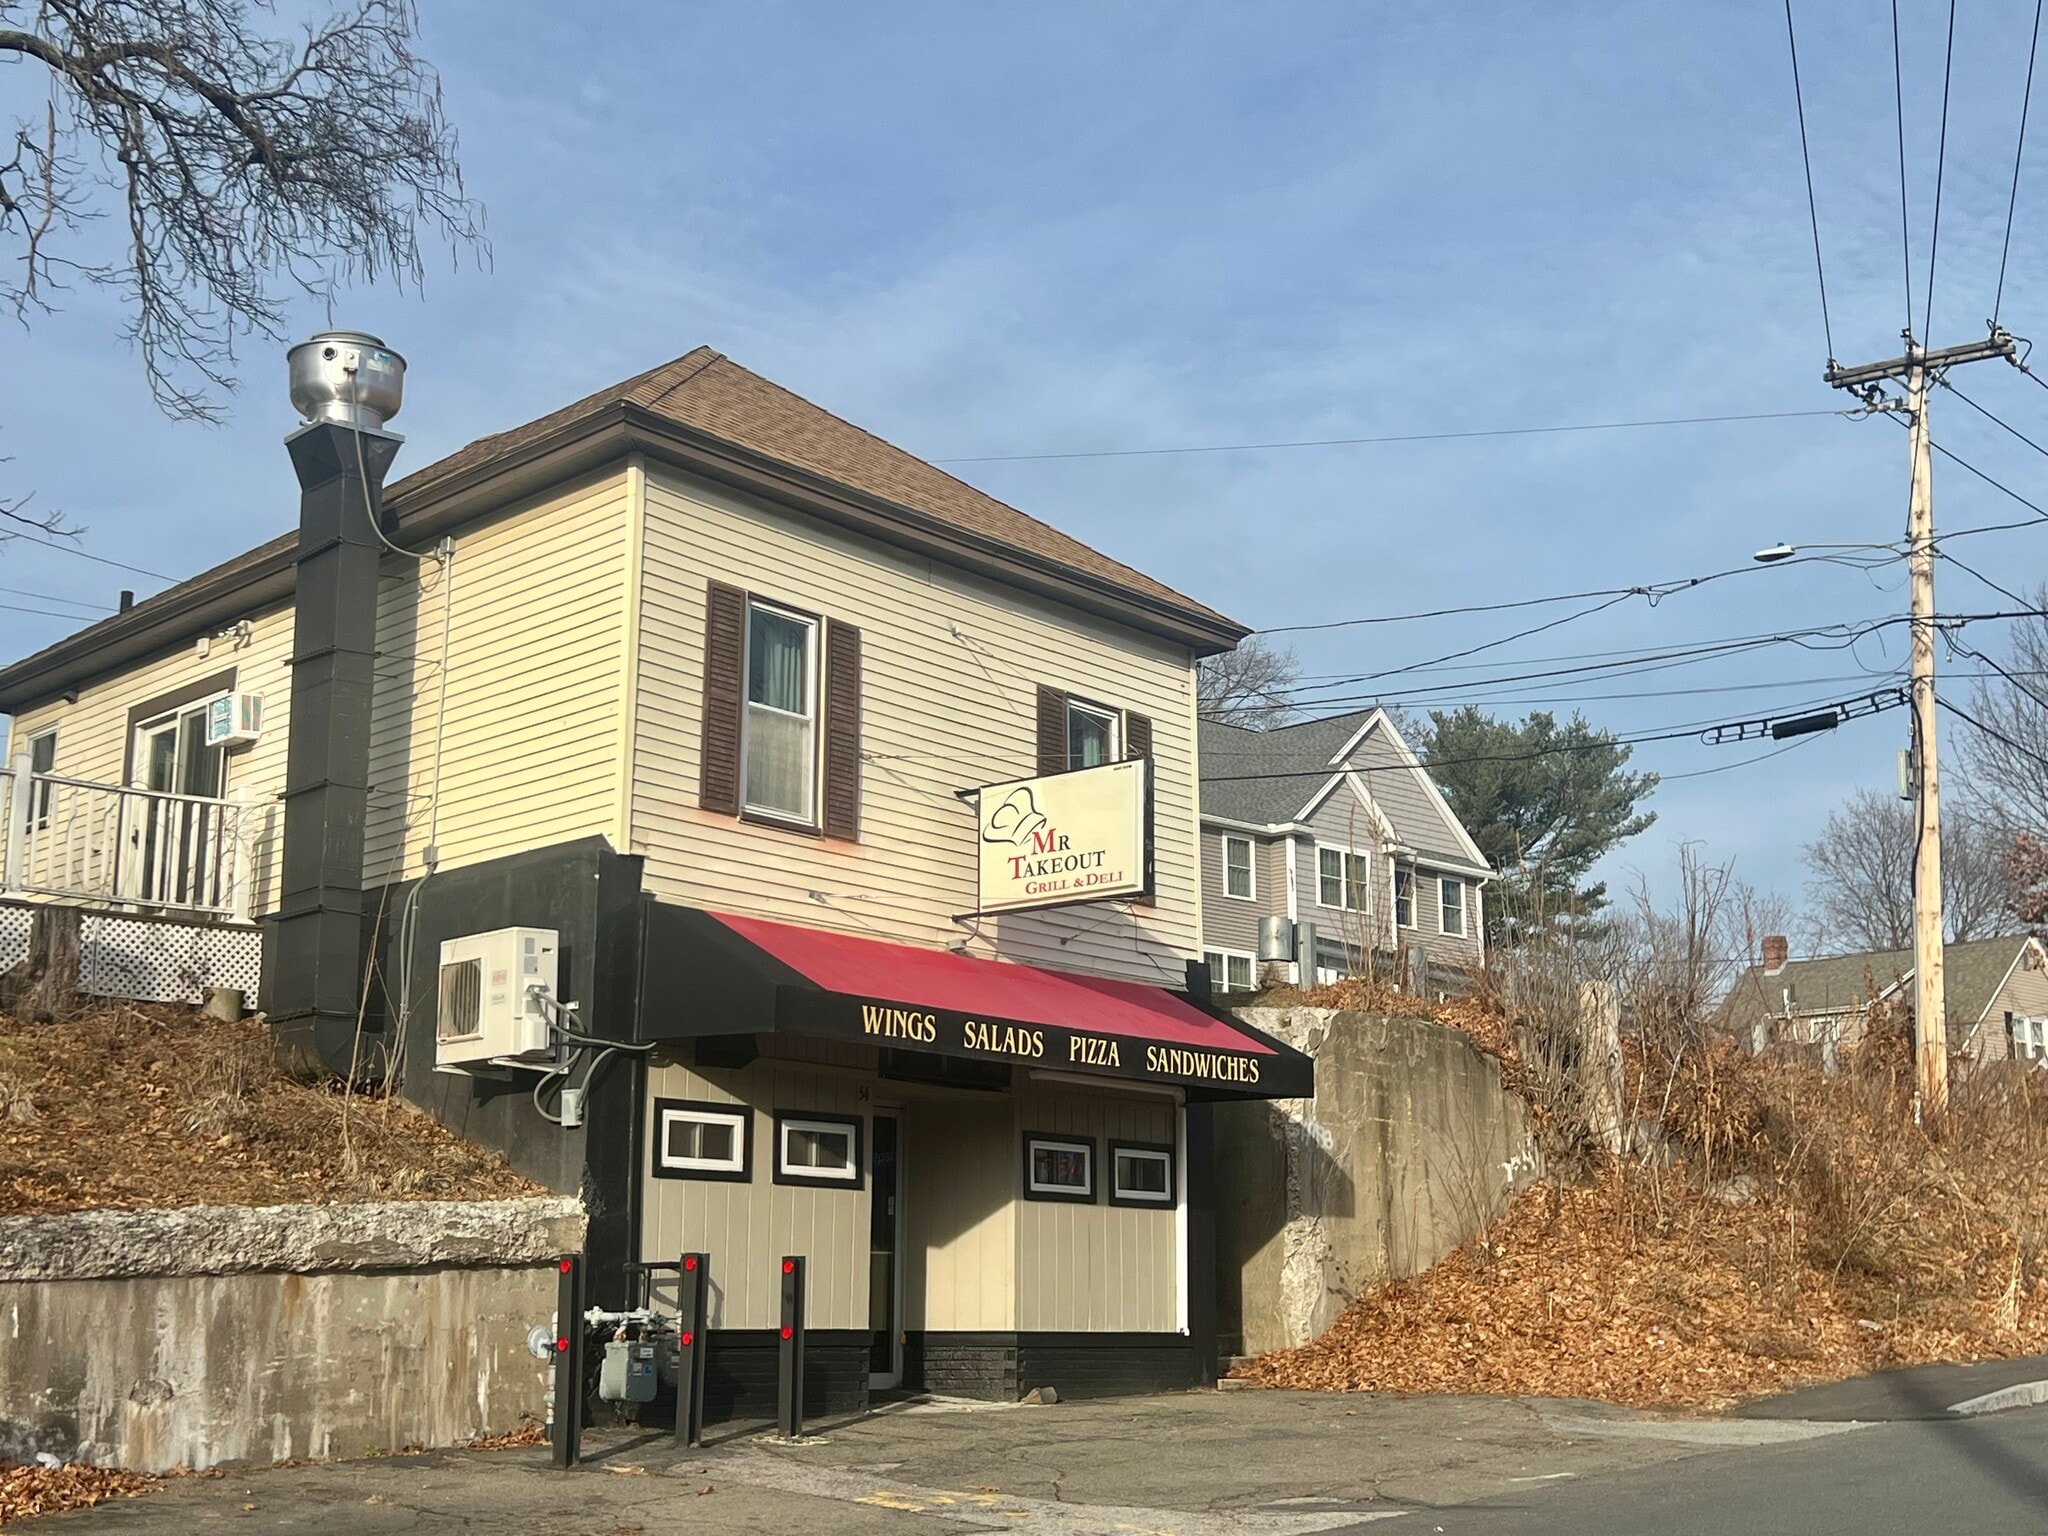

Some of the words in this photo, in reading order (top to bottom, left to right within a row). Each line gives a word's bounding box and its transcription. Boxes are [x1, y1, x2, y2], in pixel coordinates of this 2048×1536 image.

[1031, 828, 1071, 856] MR
[1007, 850, 1106, 880] TAKEOUT
[1025, 878, 1070, 895] GRILL
[862, 1005, 936, 1043] WINGS
[963, 1021, 1044, 1058] SALADS
[1069, 1035, 1120, 1067] PIZZA
[1146, 1046, 1260, 1083] SANDWICHES
